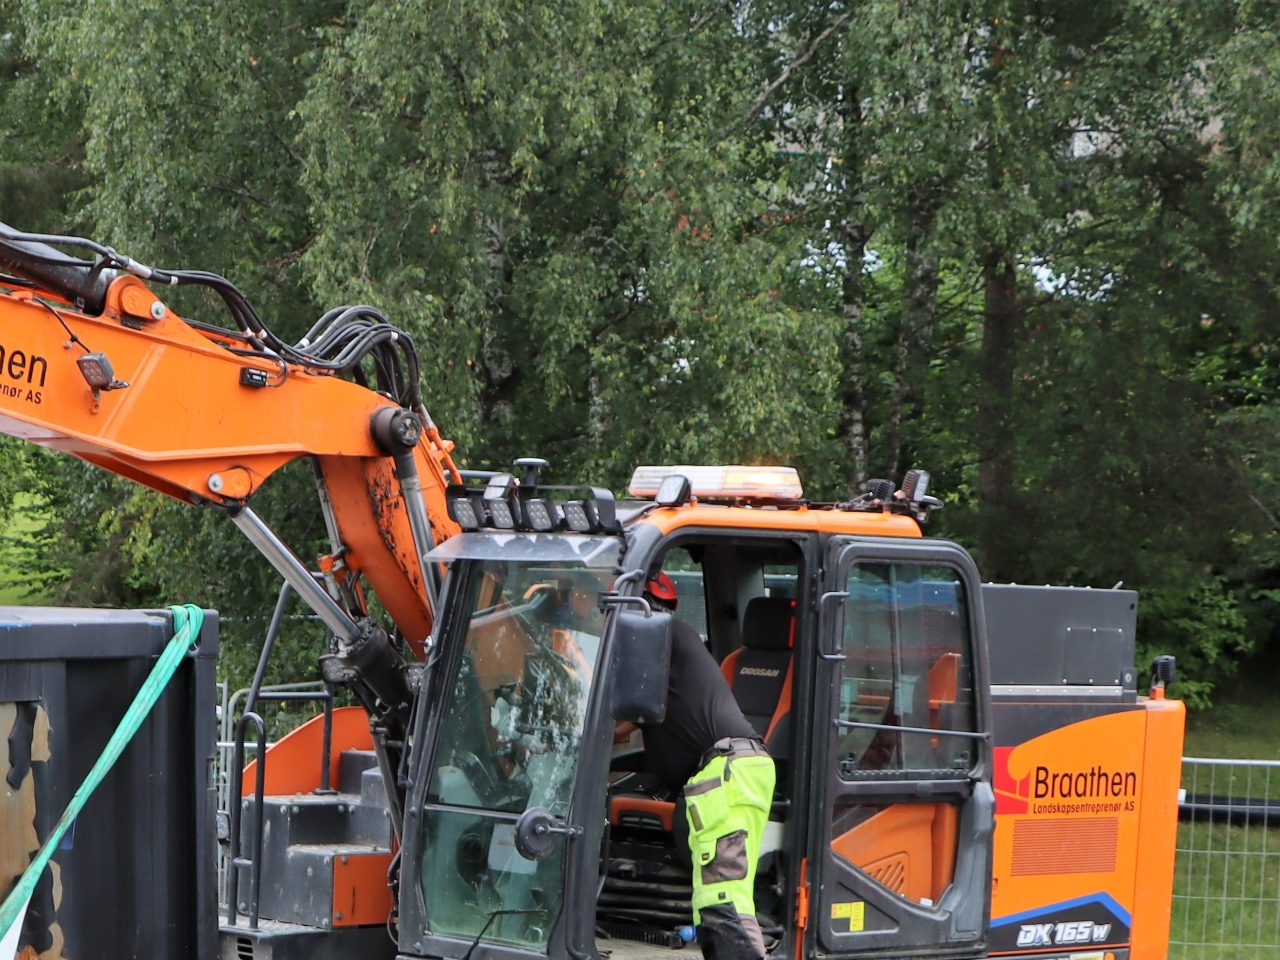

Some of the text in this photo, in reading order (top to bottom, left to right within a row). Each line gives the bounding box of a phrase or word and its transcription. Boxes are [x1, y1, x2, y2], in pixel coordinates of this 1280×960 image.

[25, 389, 43, 405] AS
[740, 666, 779, 677] DOOSAN
[1034, 765, 1137, 799] Braathen
[1033, 800, 1135, 815] Landskapsentreprenør AS
